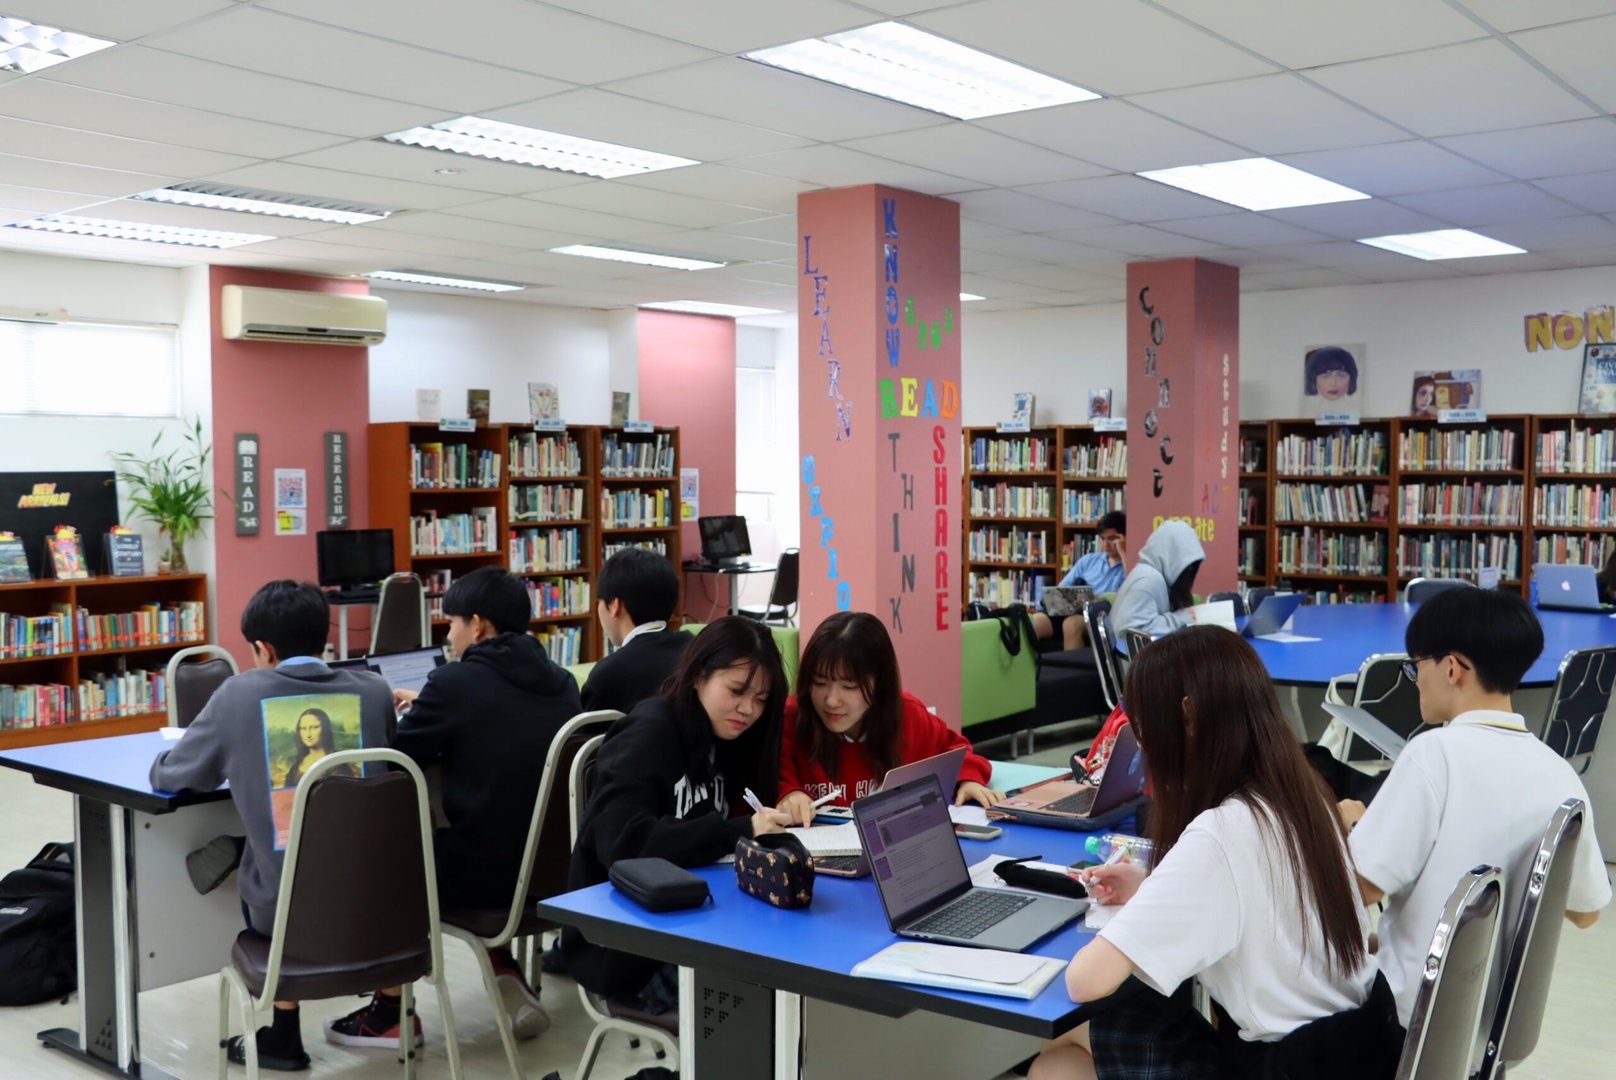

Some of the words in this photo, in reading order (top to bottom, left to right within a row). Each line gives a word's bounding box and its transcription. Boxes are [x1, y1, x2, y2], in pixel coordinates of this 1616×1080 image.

[803, 235, 853, 442] LEARN
[883, 198, 900, 368] KNOW
[1523, 304, 1616, 352] NON
[879, 376, 960, 420] READ
[242, 456, 255, 513] READ
[332, 434, 343, 514] RESEARCH
[888, 432, 916, 634] THINK
[933, 424, 950, 632] SHARE
